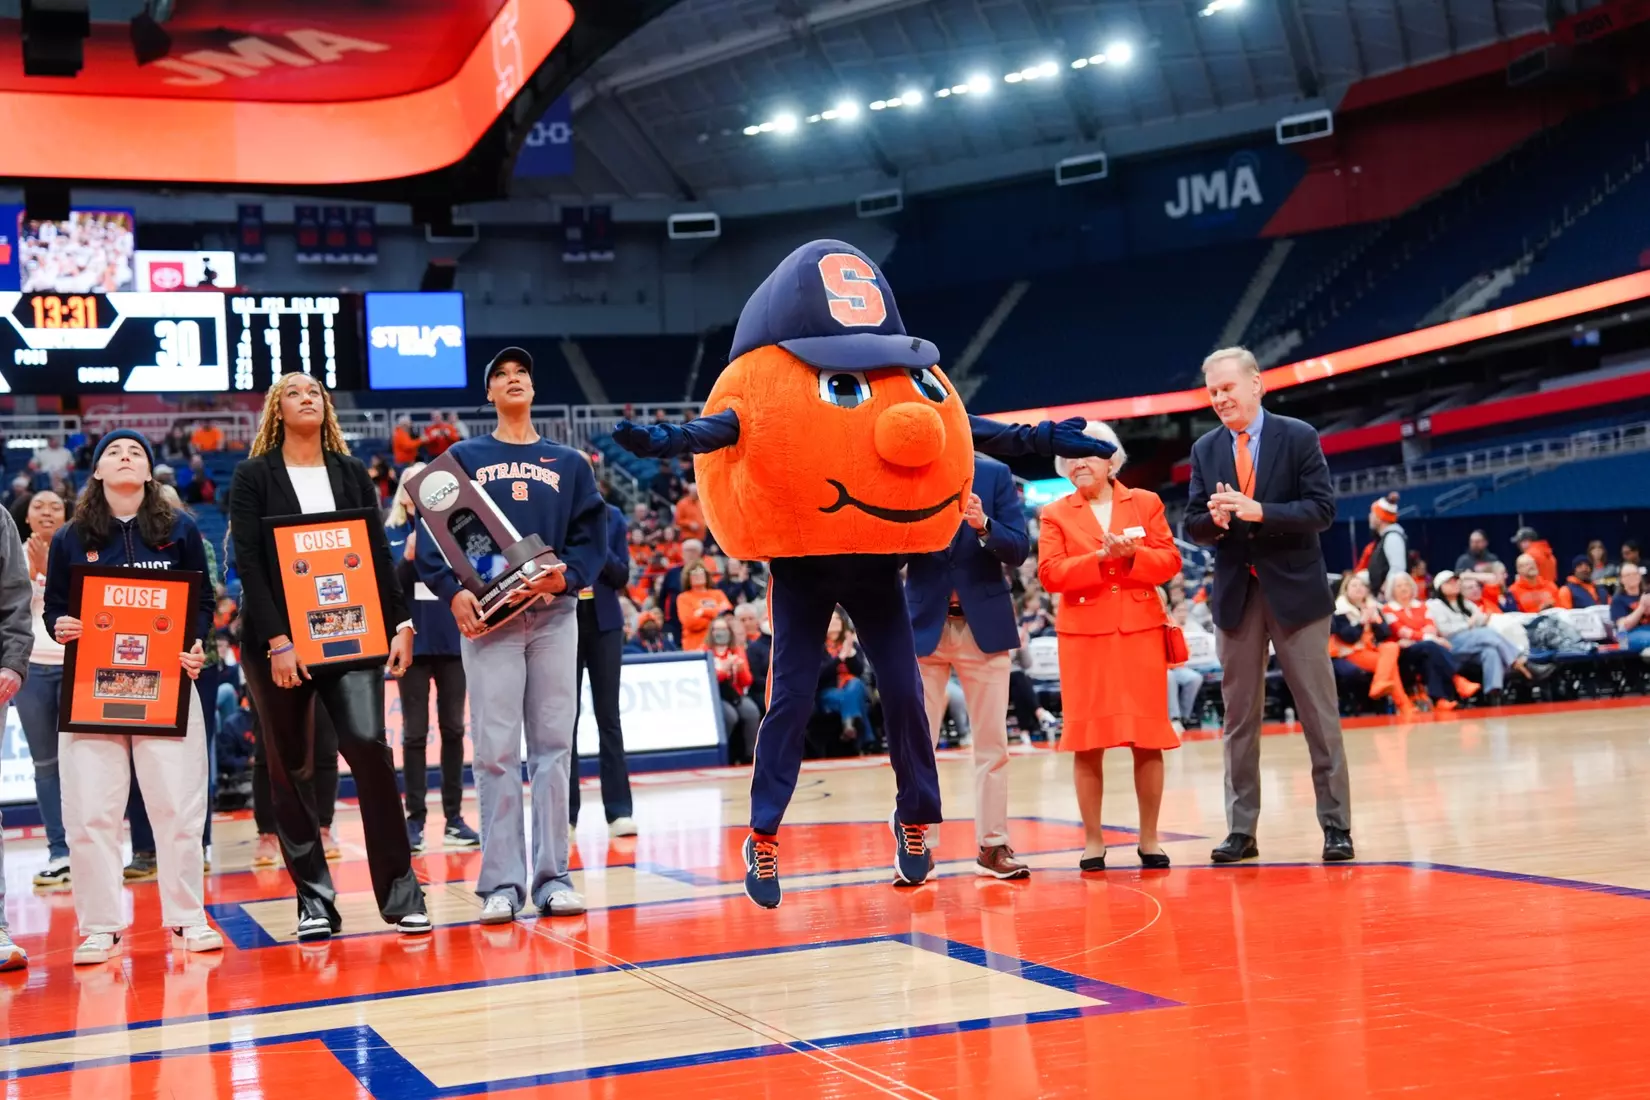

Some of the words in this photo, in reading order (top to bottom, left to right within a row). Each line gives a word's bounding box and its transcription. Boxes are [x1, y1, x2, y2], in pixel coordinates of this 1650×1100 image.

[153, 28, 391, 86] JMA
[1165, 165, 1263, 219] JMA
[818, 253, 887, 327] S
[31, 295, 98, 328] 13:31
[154, 320, 201, 366] 30
[476, 462, 560, 493] SYRACUSE
[511, 481, 528, 501] S
[426, 482, 459, 509] NCAA
[297, 530, 346, 550] 'CUSE
[107, 587, 161, 608] 'CUSE
